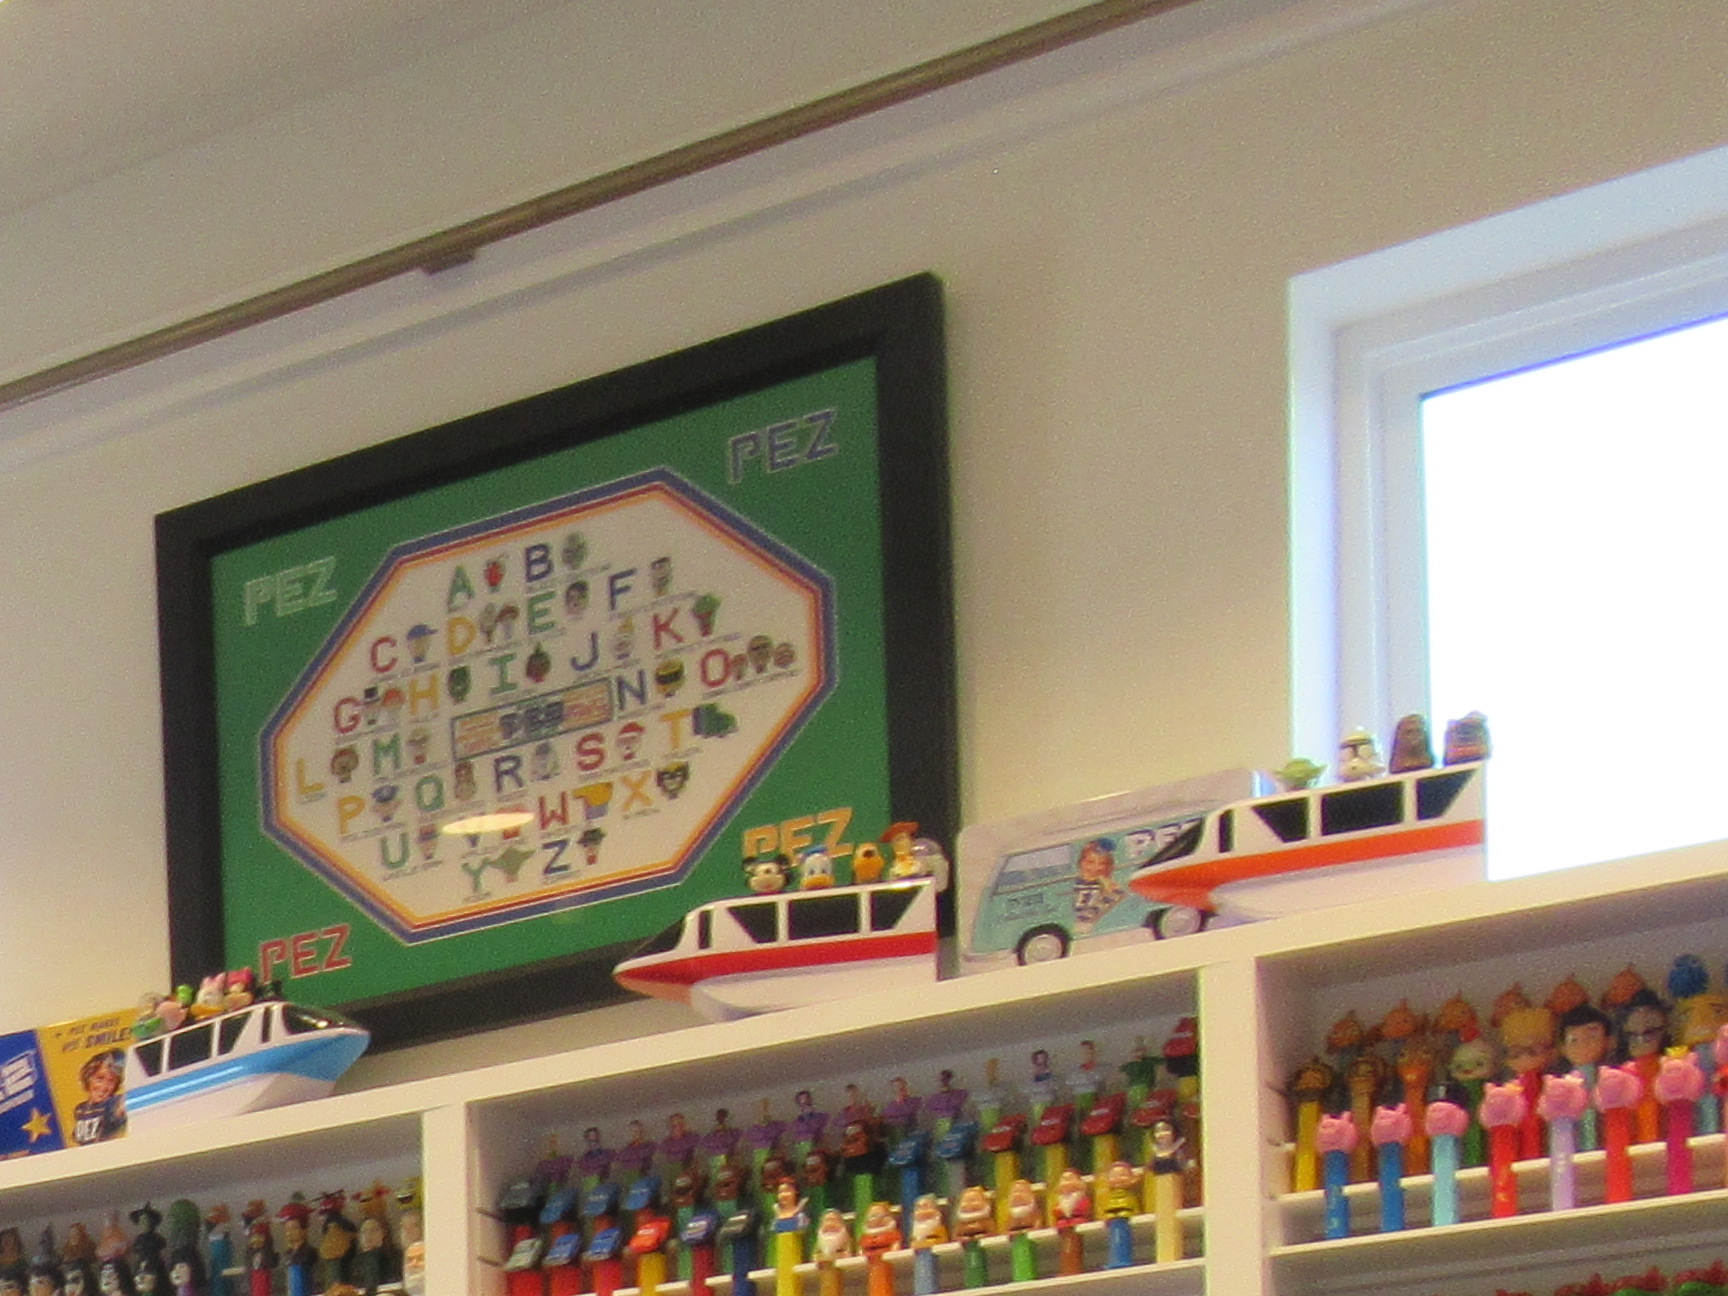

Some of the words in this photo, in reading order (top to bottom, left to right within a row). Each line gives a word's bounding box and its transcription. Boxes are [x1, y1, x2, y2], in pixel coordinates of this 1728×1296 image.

[726, 408, 839, 485] PEZ
[243, 555, 338, 627] PEZ
[447, 566, 475, 613] A
[524, 543, 555, 582] B
[370, 637, 397, 673] C
[447, 616, 477, 655] D
[527, 591, 556, 634] E
[609, 569, 637, 610] F
[334, 696, 361, 734] G
[409, 673, 439, 715] H
[489, 654, 517, 695] I
[571, 632, 598, 671] J
[653, 608, 684, 649] K
[297, 759, 324, 795] L
[373, 734, 400, 776] M
[616, 670, 646, 710] N
[701, 649, 730, 688] O
[336, 795, 365, 835] P
[494, 755, 524, 792] R
[575, 733, 605, 771] S
[660, 709, 693, 749] T
[381, 832, 409, 869] U
[539, 791, 567, 830] W
[621, 770, 653, 811] X
[744, 807, 855, 860] PEZ
[462, 857, 492, 892] Y
[542, 839, 570, 874] Z
[259, 923, 352, 982] PEZ
